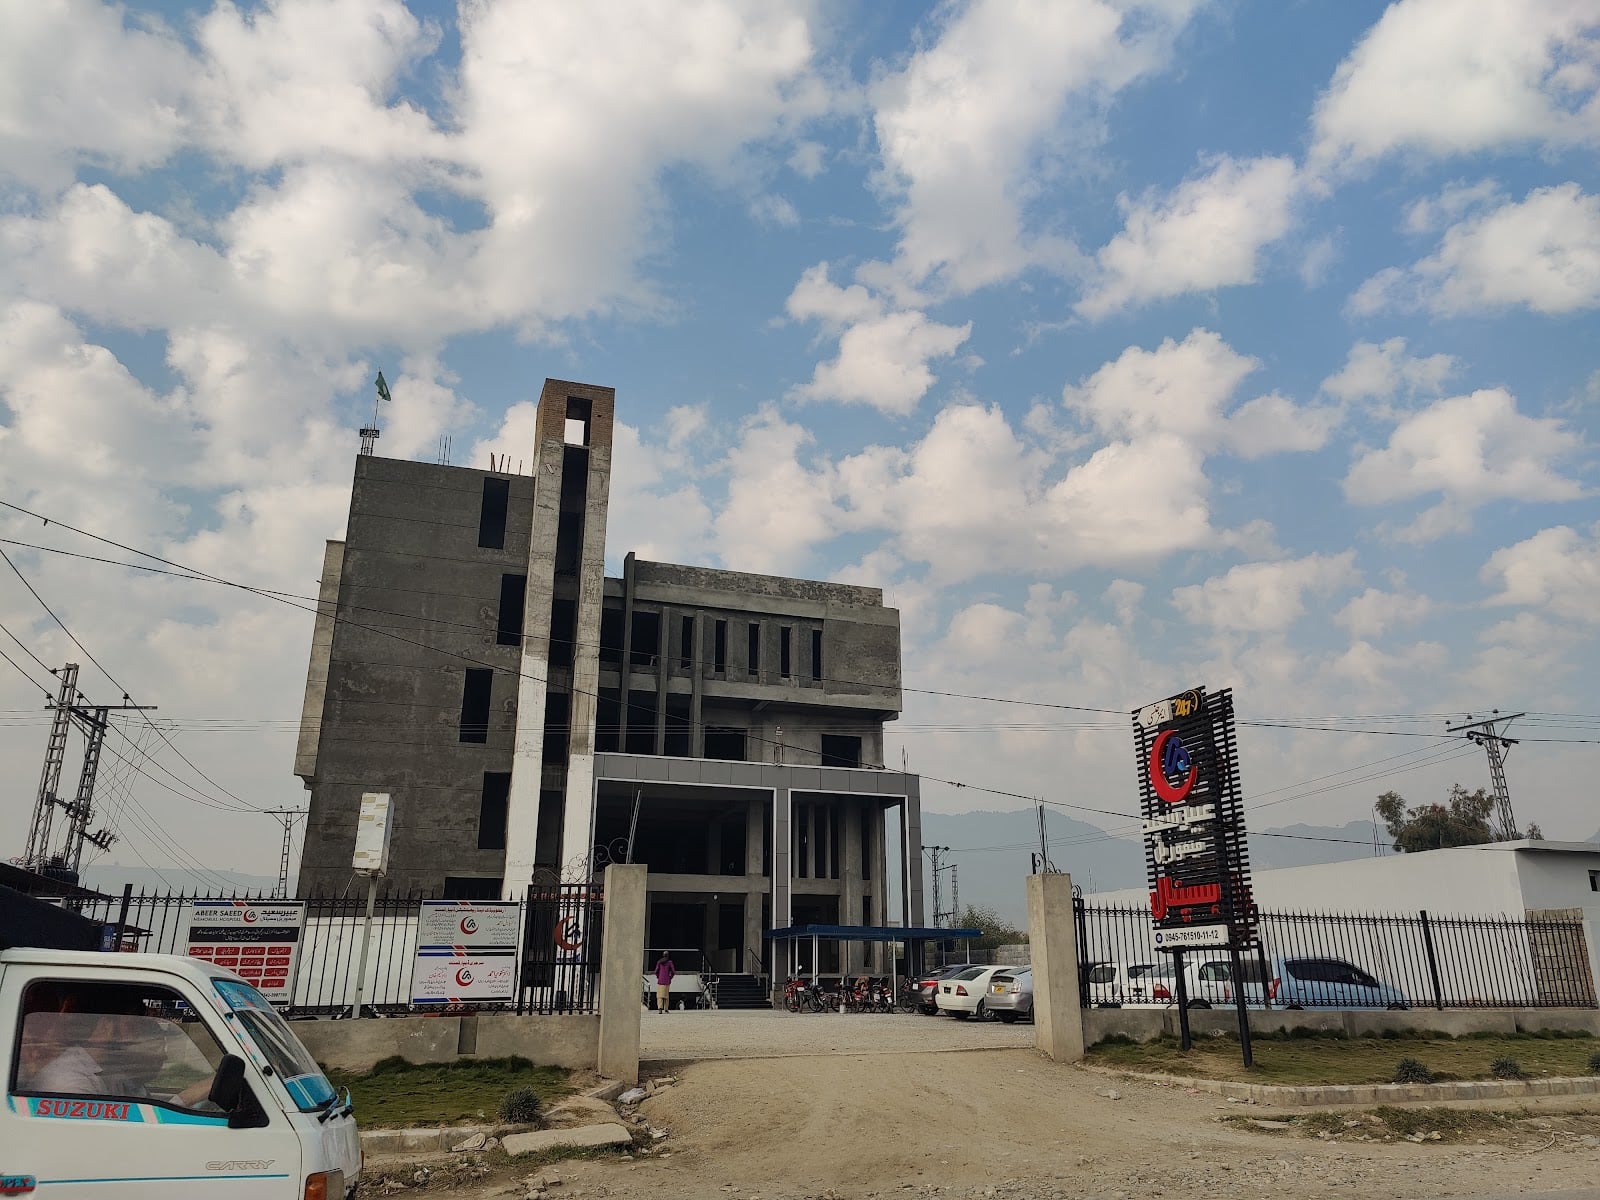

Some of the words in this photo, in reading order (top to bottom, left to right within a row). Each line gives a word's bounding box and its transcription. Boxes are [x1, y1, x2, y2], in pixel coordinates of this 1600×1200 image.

[219, 909, 243, 917] SAEED
[36, 1099, 130, 1120] SUZUKI
[206, 1159, 275, 1170] CARRY
